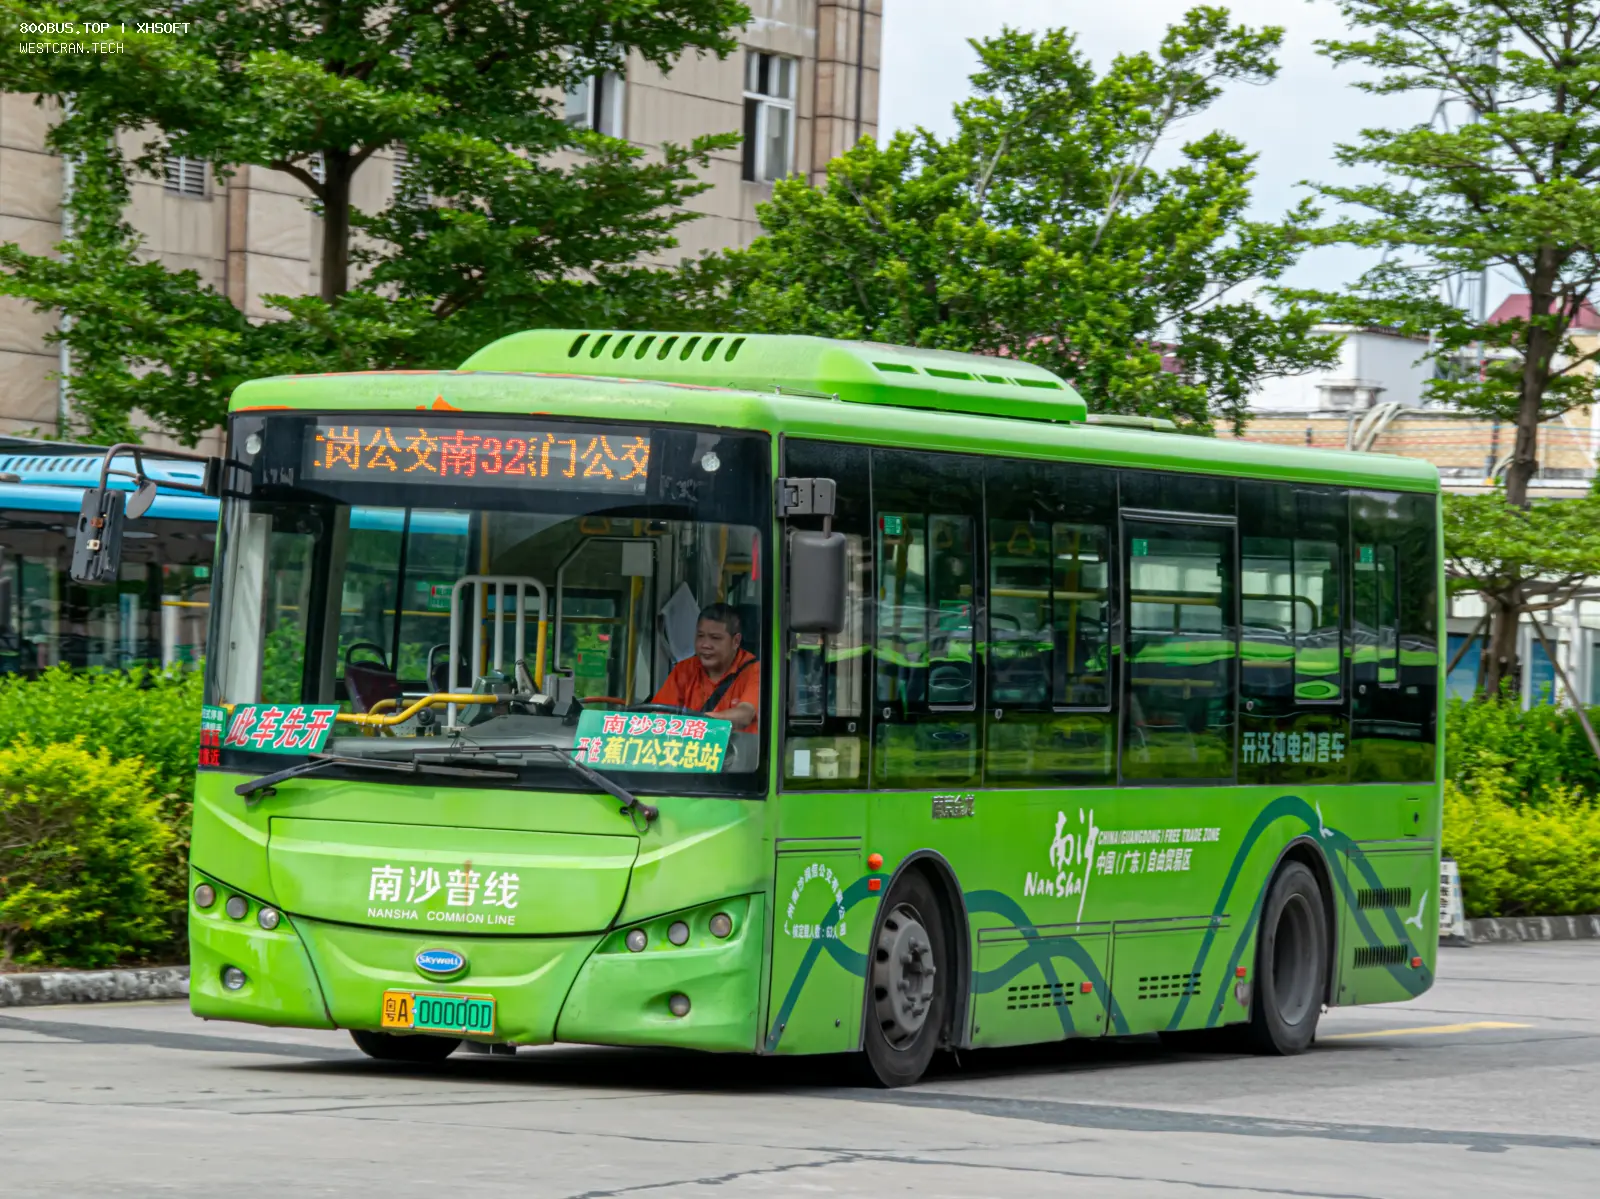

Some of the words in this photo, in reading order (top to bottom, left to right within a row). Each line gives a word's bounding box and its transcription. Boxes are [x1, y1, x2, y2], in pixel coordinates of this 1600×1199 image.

[314, 426, 438, 473] 岗公交
[224, 706, 335, 749] 此车先开
[602, 713, 708, 740] 南沙32路
[601, 735, 723, 772] 蕉门公交总站
[1241, 731, 1345, 764] 开沃纯电动客车
[368, 864, 520, 909] 南沙普线
[367, 907, 419, 921] NANSHA
[427, 910, 484, 924] COMMON
[487, 914, 516, 926] LINE
